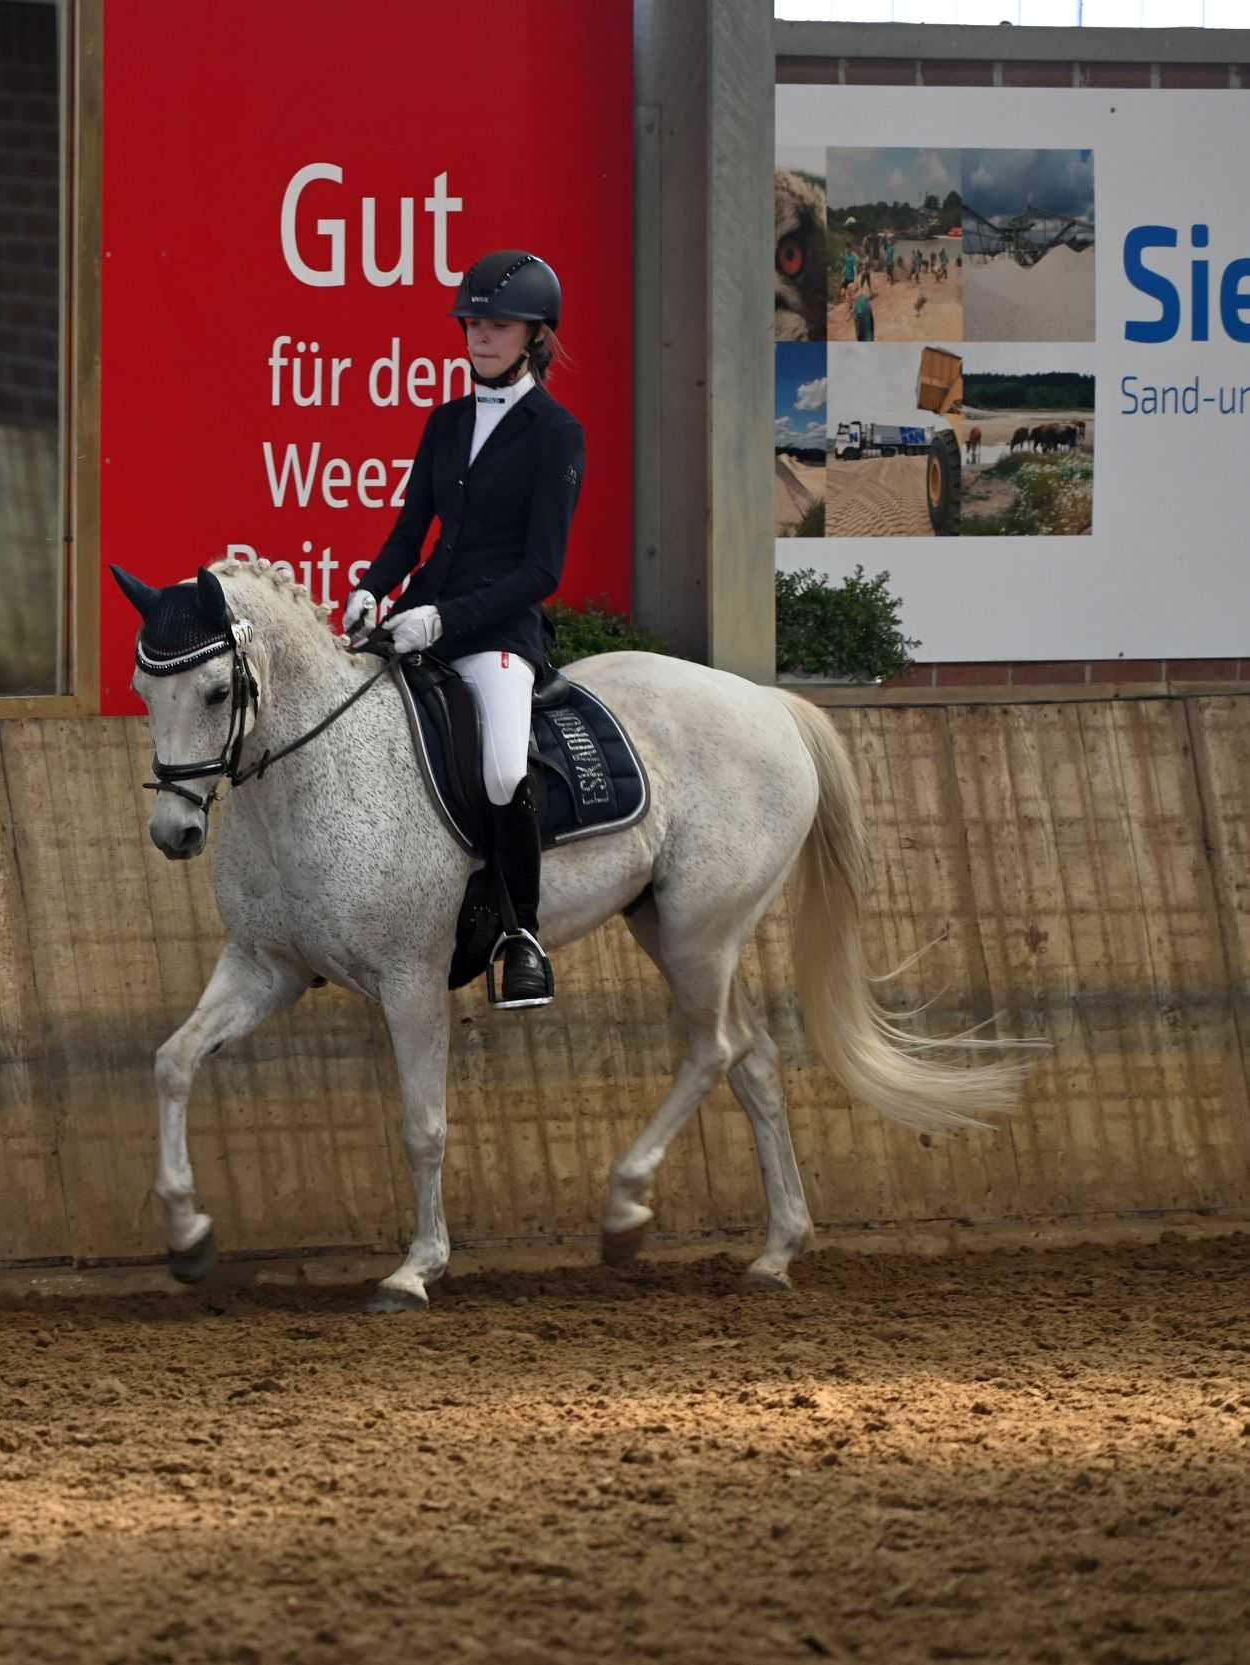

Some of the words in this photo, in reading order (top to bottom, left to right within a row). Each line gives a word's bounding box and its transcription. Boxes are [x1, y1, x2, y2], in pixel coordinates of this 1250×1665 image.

[280, 162, 464, 287] Gut
[268, 336, 352, 408] für
[368, 337, 472, 408] den
[262, 441, 413, 508] Weez
